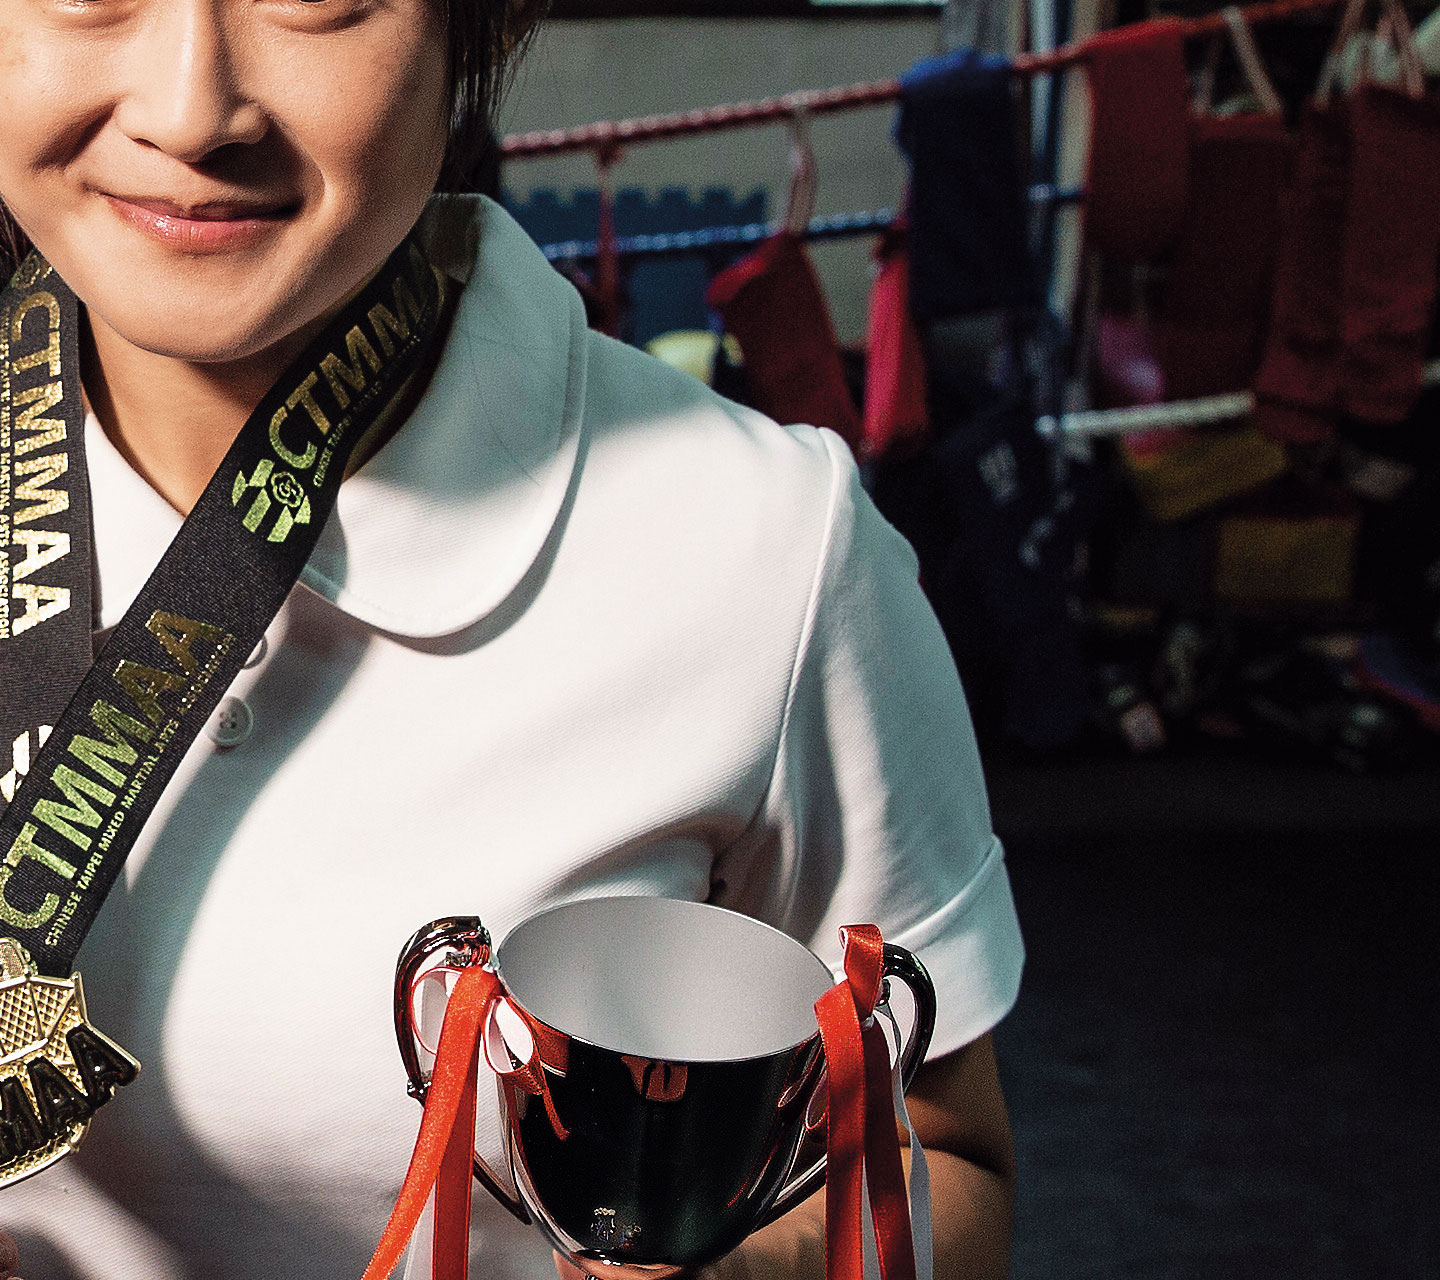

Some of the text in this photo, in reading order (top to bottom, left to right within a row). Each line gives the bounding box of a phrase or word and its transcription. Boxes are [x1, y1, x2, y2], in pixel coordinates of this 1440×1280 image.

[9, 291, 72, 637] CTMMAA
[44, 893, 83, 946] CHINESE
[76, 853, 104, 891] TAIPEI
[98, 811, 126, 852] MIXED
[121, 756, 157, 809] MARTIAL
[153, 718, 181, 756] ARTS
